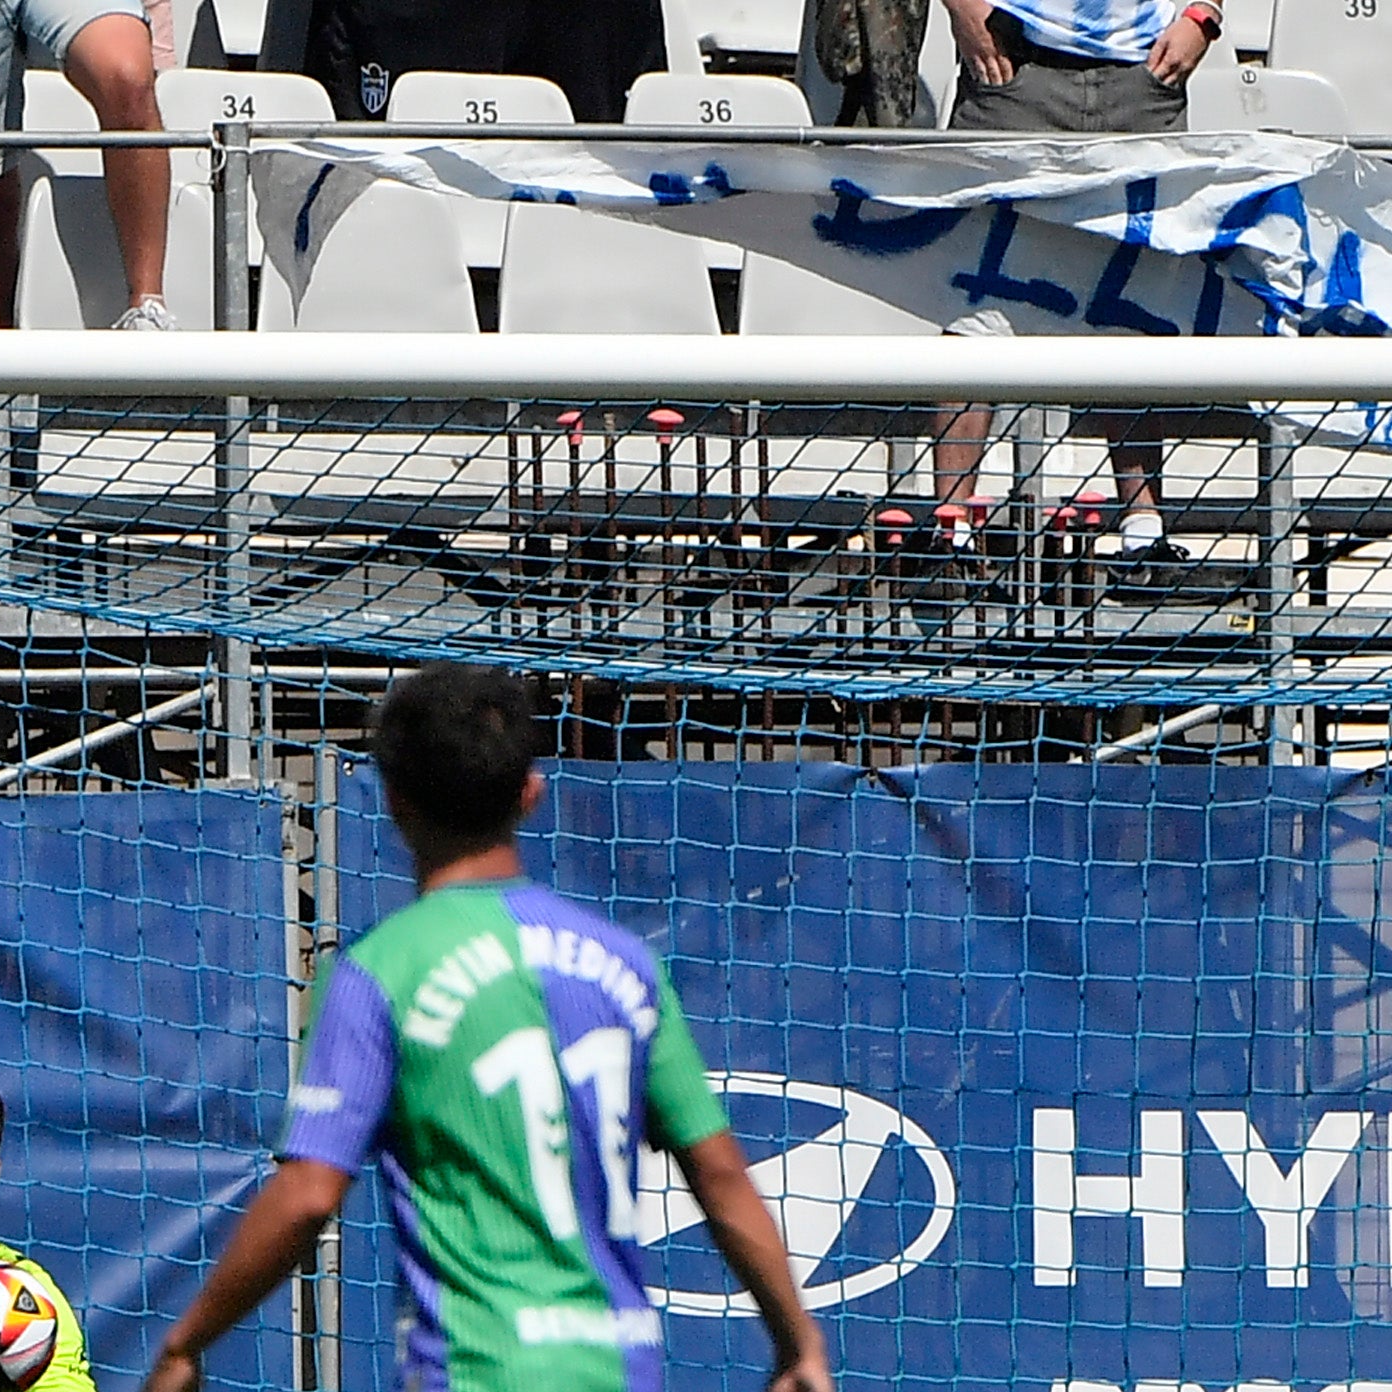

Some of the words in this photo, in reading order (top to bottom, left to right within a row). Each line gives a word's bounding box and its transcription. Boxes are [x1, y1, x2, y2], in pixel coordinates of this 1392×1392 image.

[222, 95, 257, 120] 34
[465, 100, 499, 124] 35
[698, 99, 733, 124] 36
[472, 1026, 638, 1242] 11
[1032, 1107, 1392, 1288] HY
